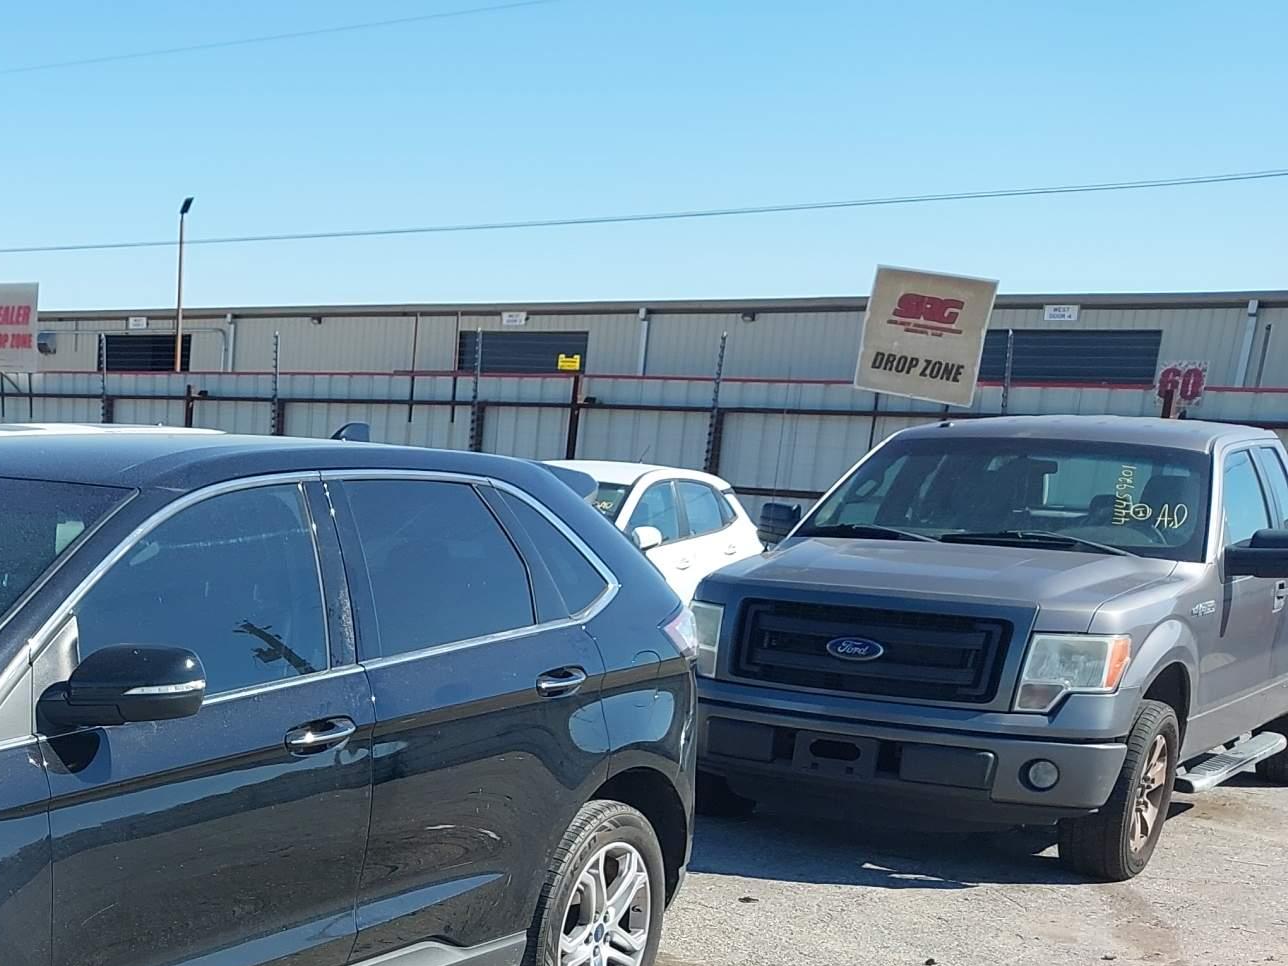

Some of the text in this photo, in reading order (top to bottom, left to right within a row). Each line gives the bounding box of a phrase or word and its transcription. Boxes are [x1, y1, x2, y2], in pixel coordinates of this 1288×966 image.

[10, 333, 32, 349] ZONE
[871, 351, 965, 383] DROP ZONE
[1158, 367, 1204, 400] 60
[837, 640, 870, 656] Ford
